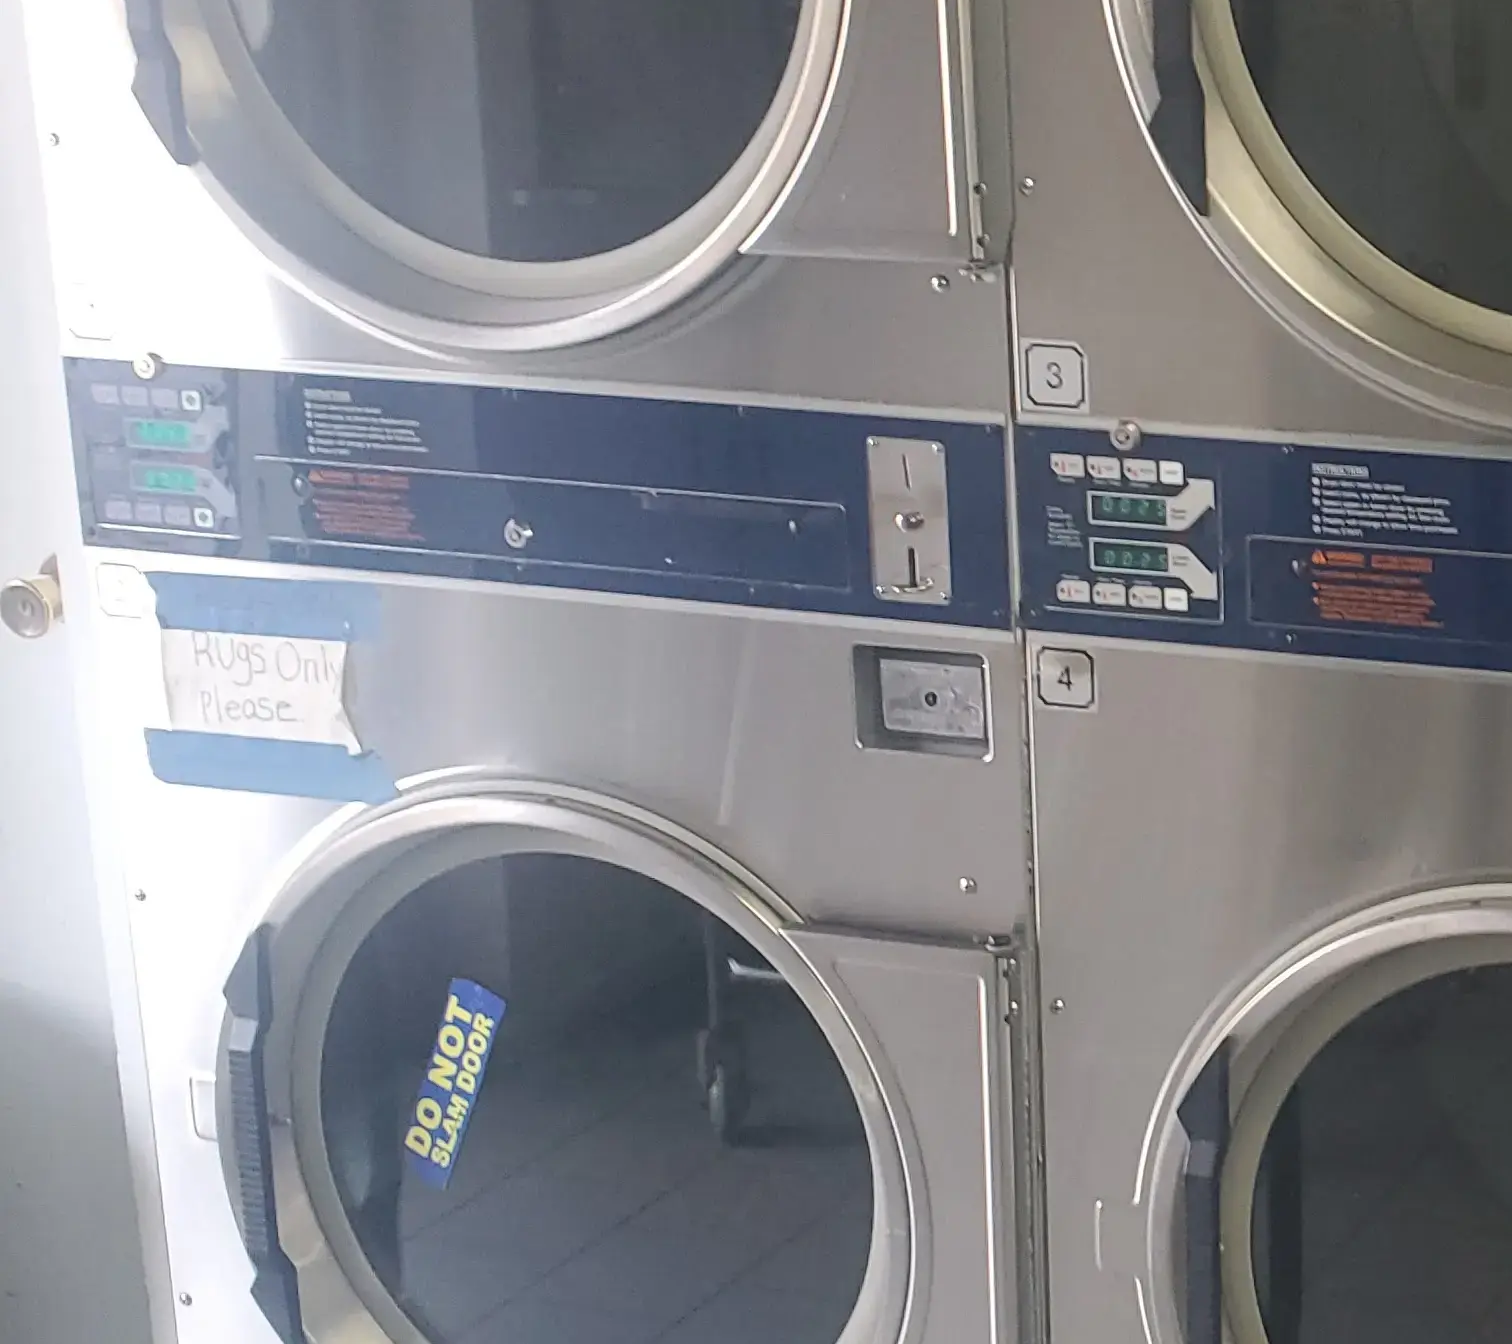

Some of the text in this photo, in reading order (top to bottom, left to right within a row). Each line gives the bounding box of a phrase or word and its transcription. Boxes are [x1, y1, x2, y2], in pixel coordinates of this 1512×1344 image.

[1045, 360, 1064, 391] 3
[1057, 665, 1074, 691] 4
[404, 993, 473, 1159] DO NOT
[430, 1012, 495, 1169] SLAM DOOR
